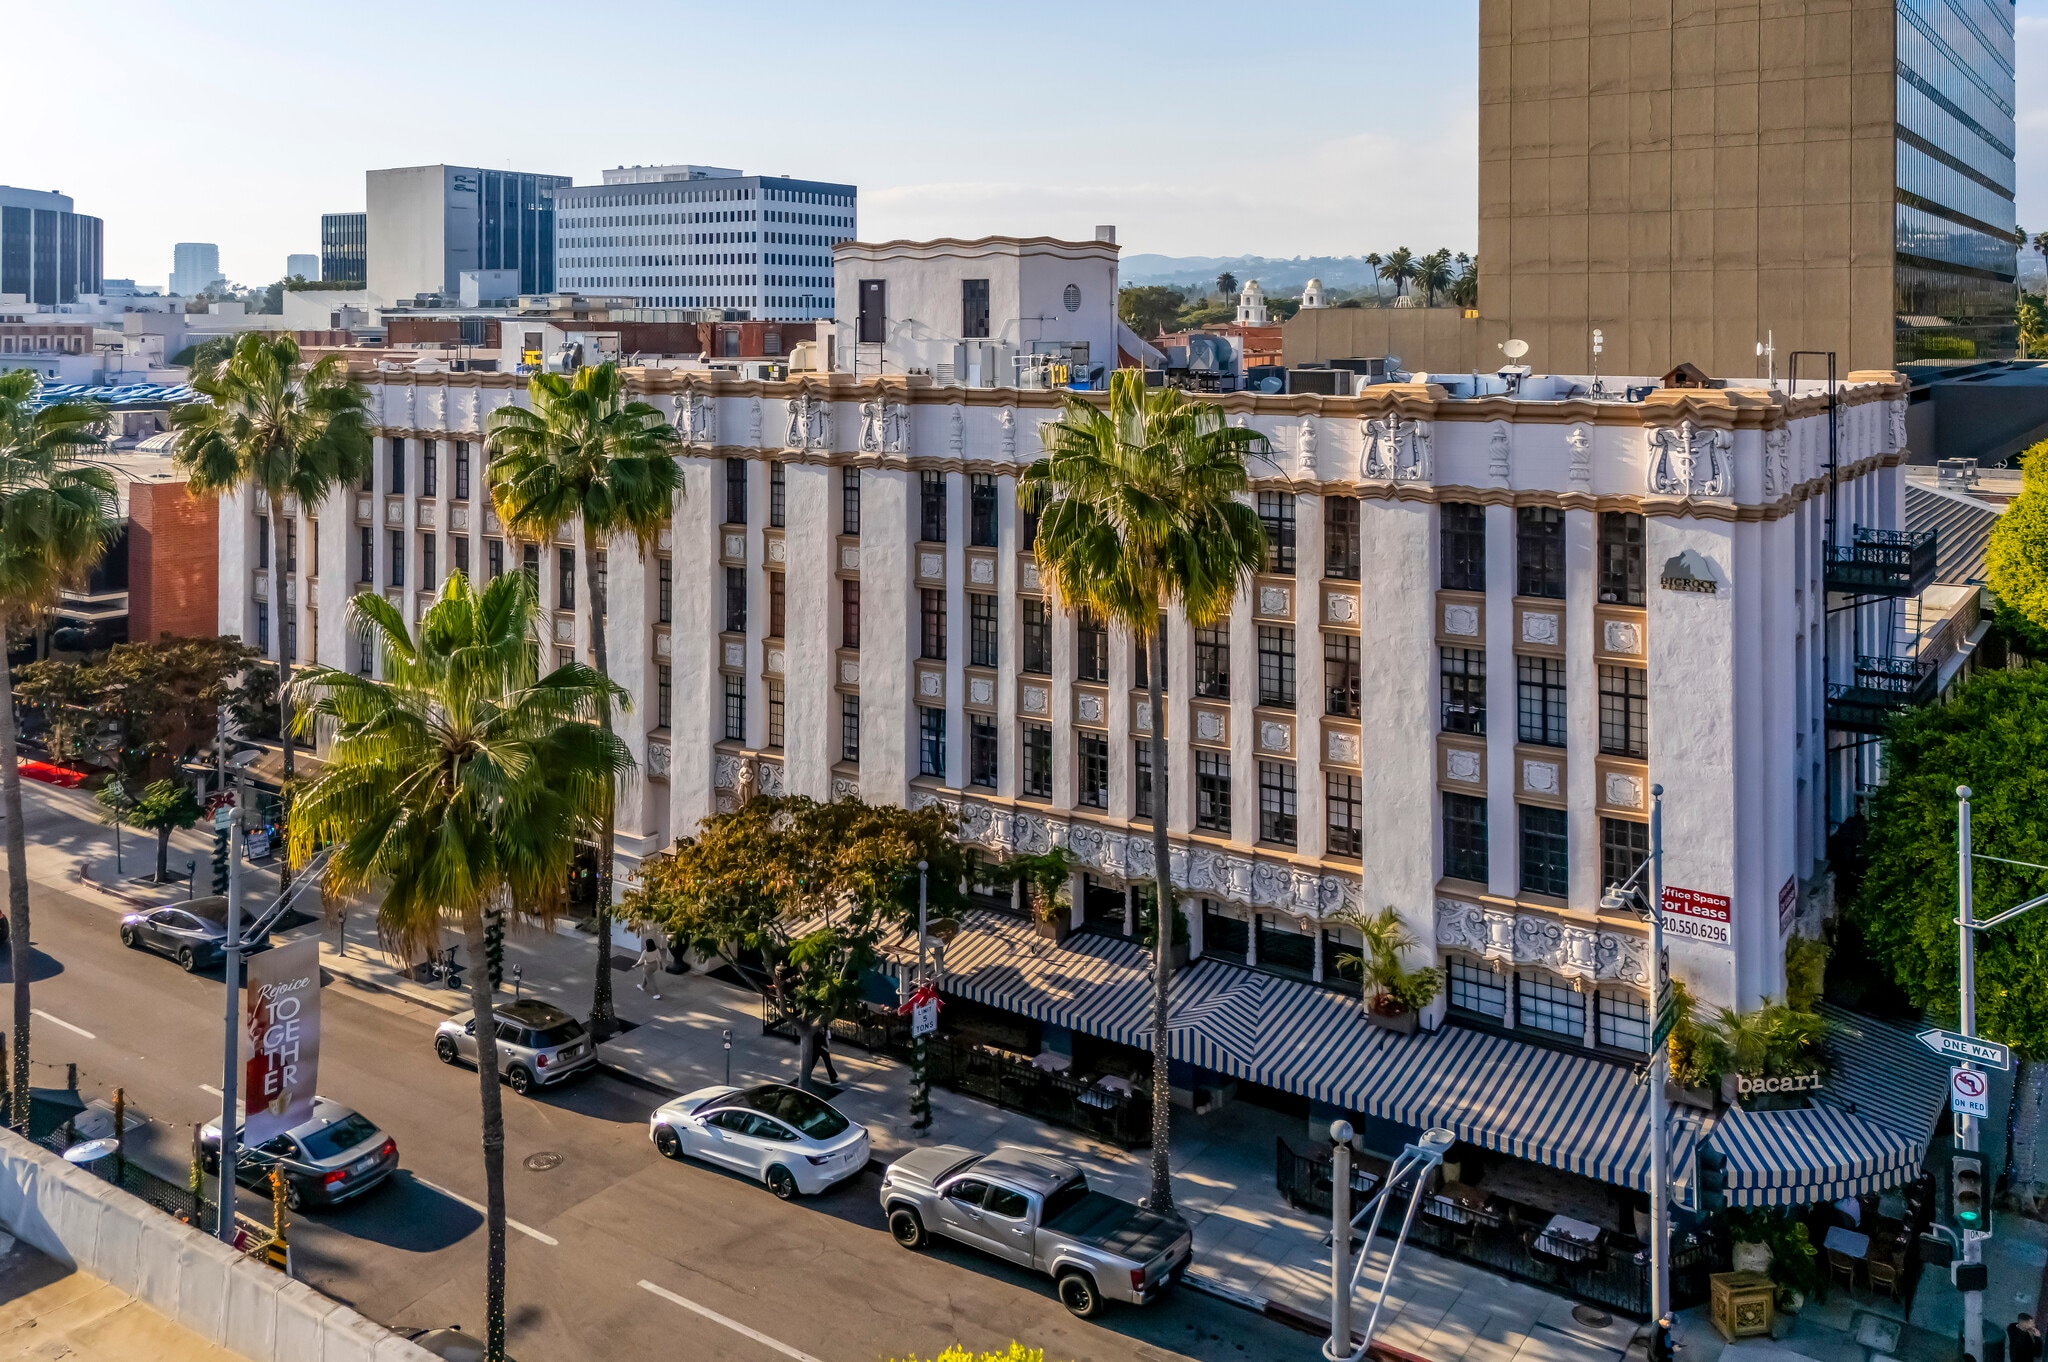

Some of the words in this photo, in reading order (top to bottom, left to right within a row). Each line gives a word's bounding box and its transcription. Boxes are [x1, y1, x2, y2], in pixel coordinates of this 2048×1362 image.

[1684, 902, 1727, 920] Lease
[1693, 893, 1727, 906] Space
[1662, 916, 1727, 942] 10.550.6296
[258, 977, 310, 1002] Rejoice
[265, 997, 300, 1025] TO
[922, 1014, 928, 1022] 5
[263, 1018, 300, 1048] GE
[916, 1020, 934, 1033] TONS
[264, 1041, 300, 1071] TH
[1943, 1039, 1968, 1053] ONE
[1972, 1046, 1997, 1059] WAY
[264, 1065, 298, 1095] ER
[1735, 1070, 1823, 1093] bacari
[1954, 1098, 1966, 1107] ON
[1970, 1101, 1985, 1111] RED
